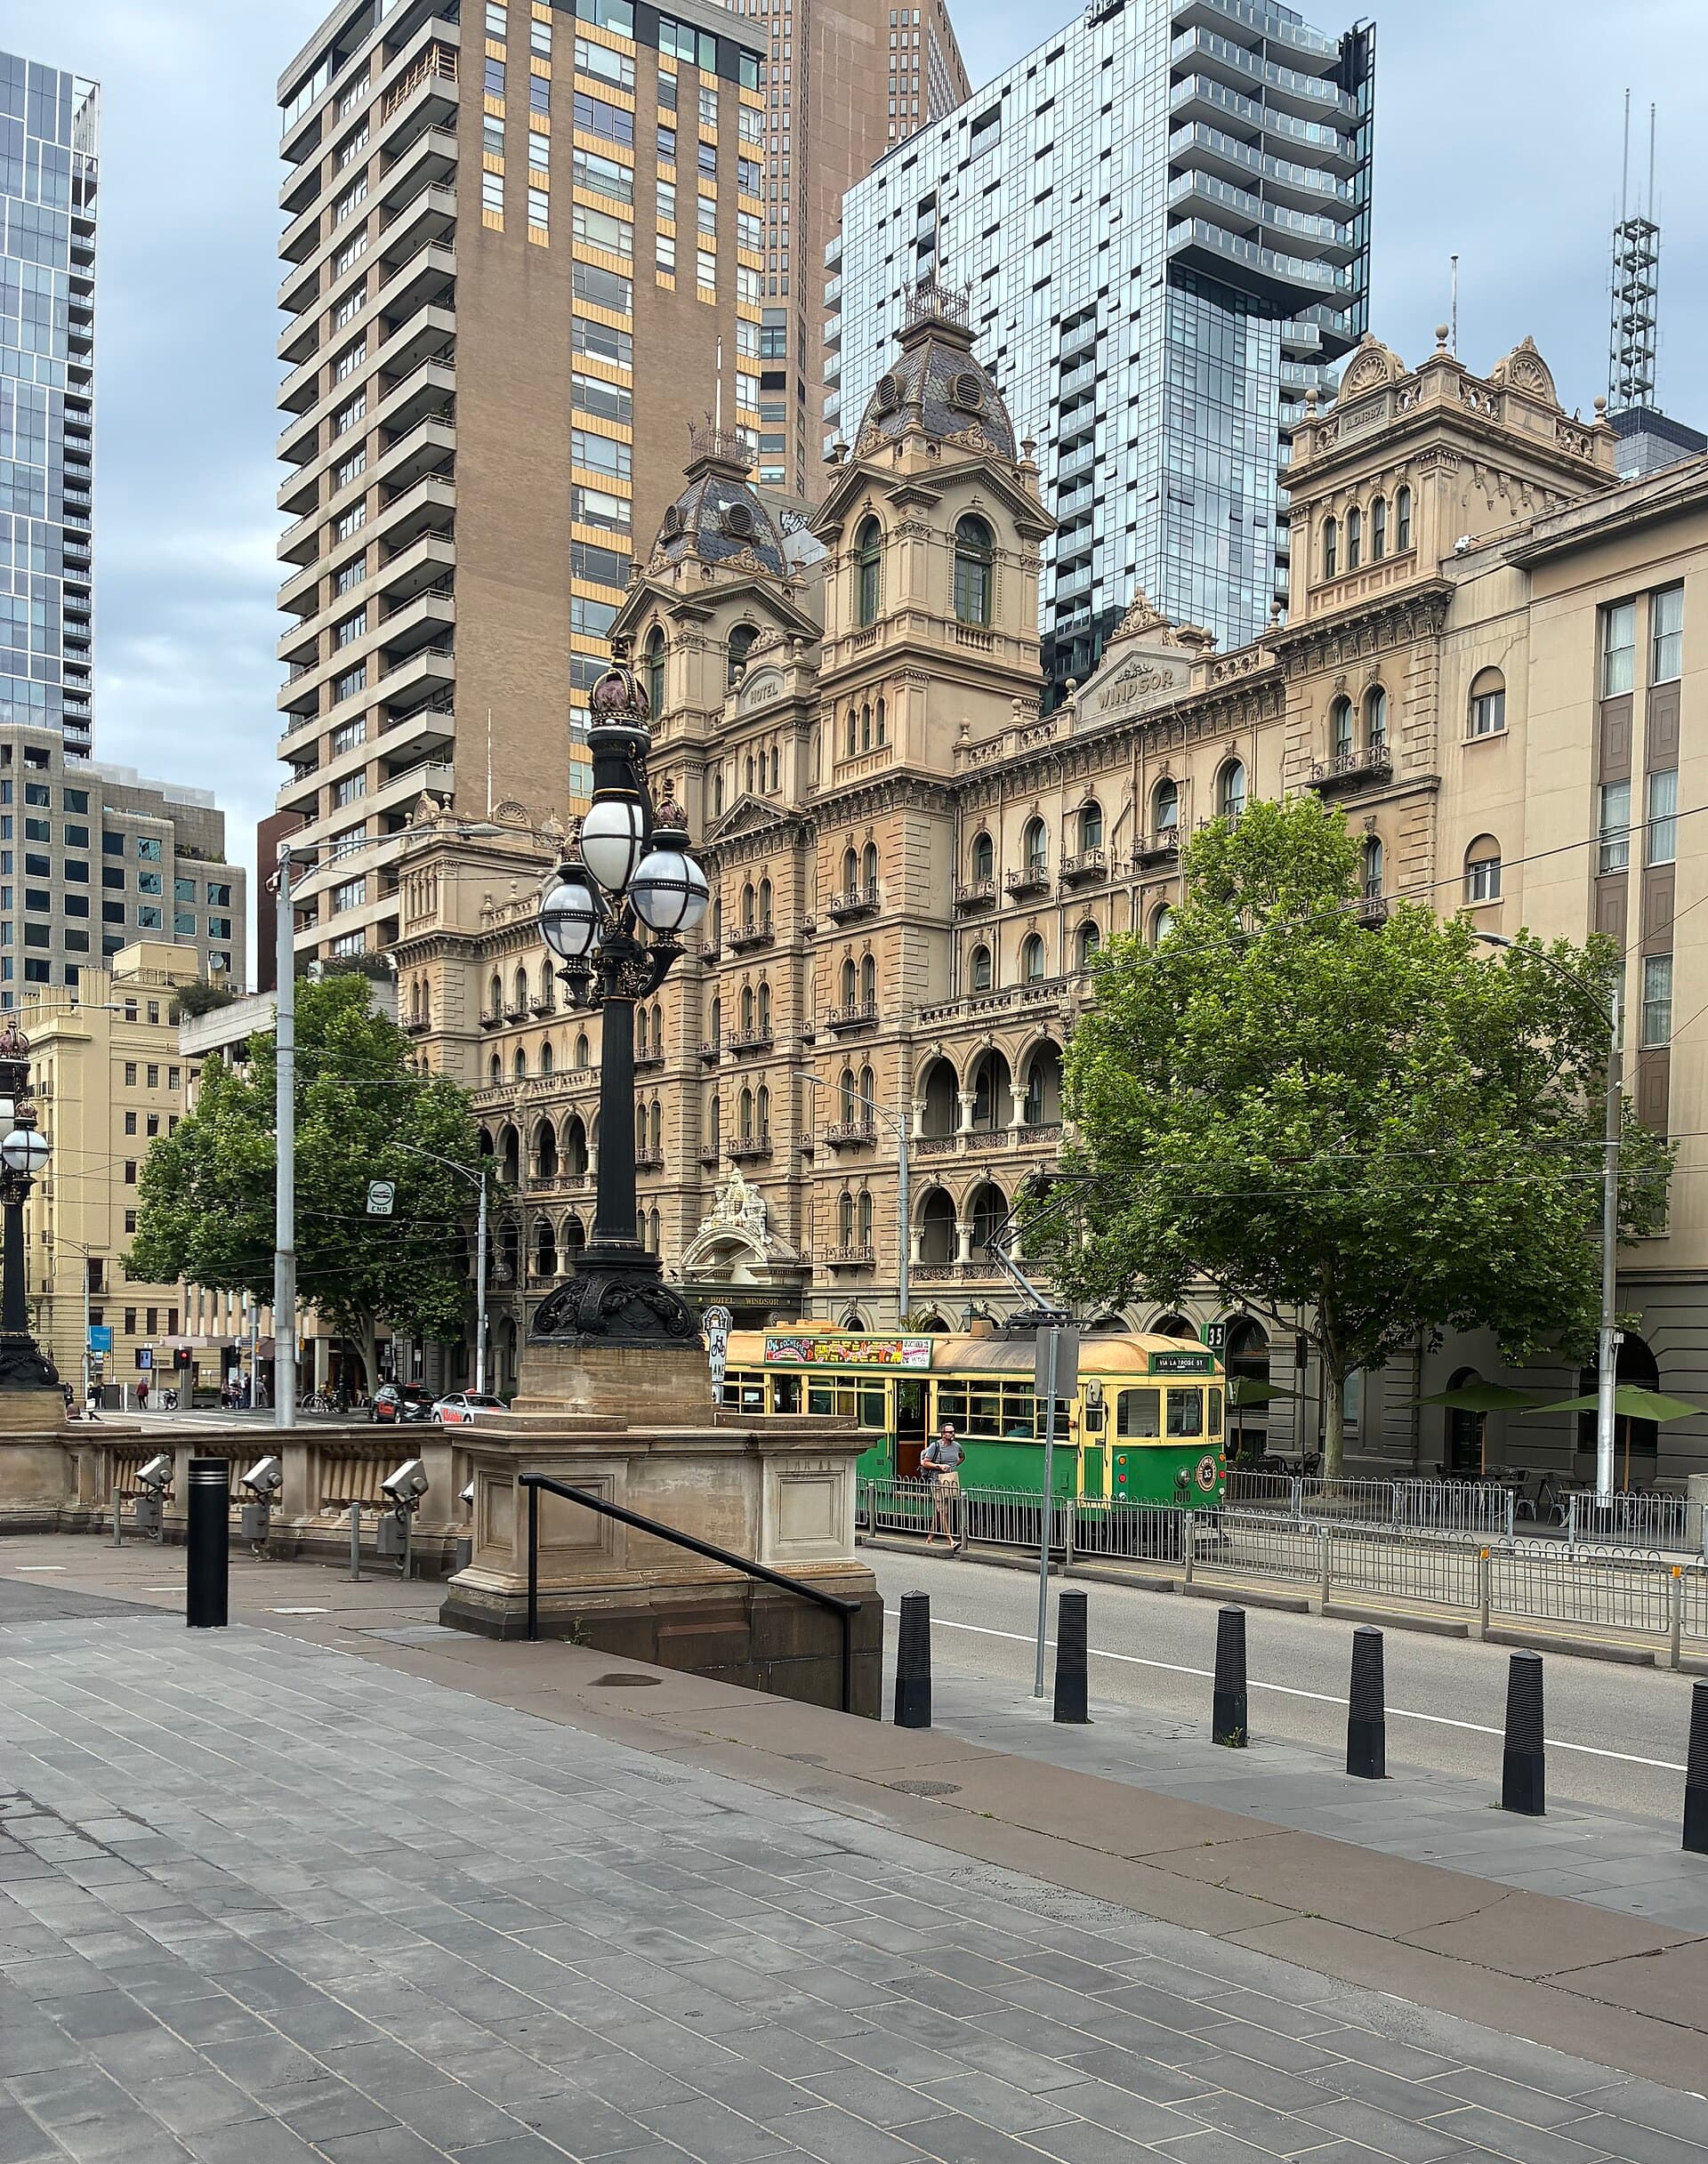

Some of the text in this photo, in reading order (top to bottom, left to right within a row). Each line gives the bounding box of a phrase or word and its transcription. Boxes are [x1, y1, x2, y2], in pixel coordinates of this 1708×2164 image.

[750, 681, 778, 704] HOTEL
[1098, 669, 1174, 709] WINDSOR
[710, 1296, 779, 1306] HOTEL WINDSOR
[1208, 1327, 1222, 1345] 35
[1159, 1358, 1168, 1366] VIA
[1169, 1358, 1177, 1366] LA
[1196, 1358, 1204, 1366] ST
[712, 1364, 724, 1376] ANE
[1204, 1468, 1212, 1478] 35
[1173, 1490, 1191, 1502] 1010
